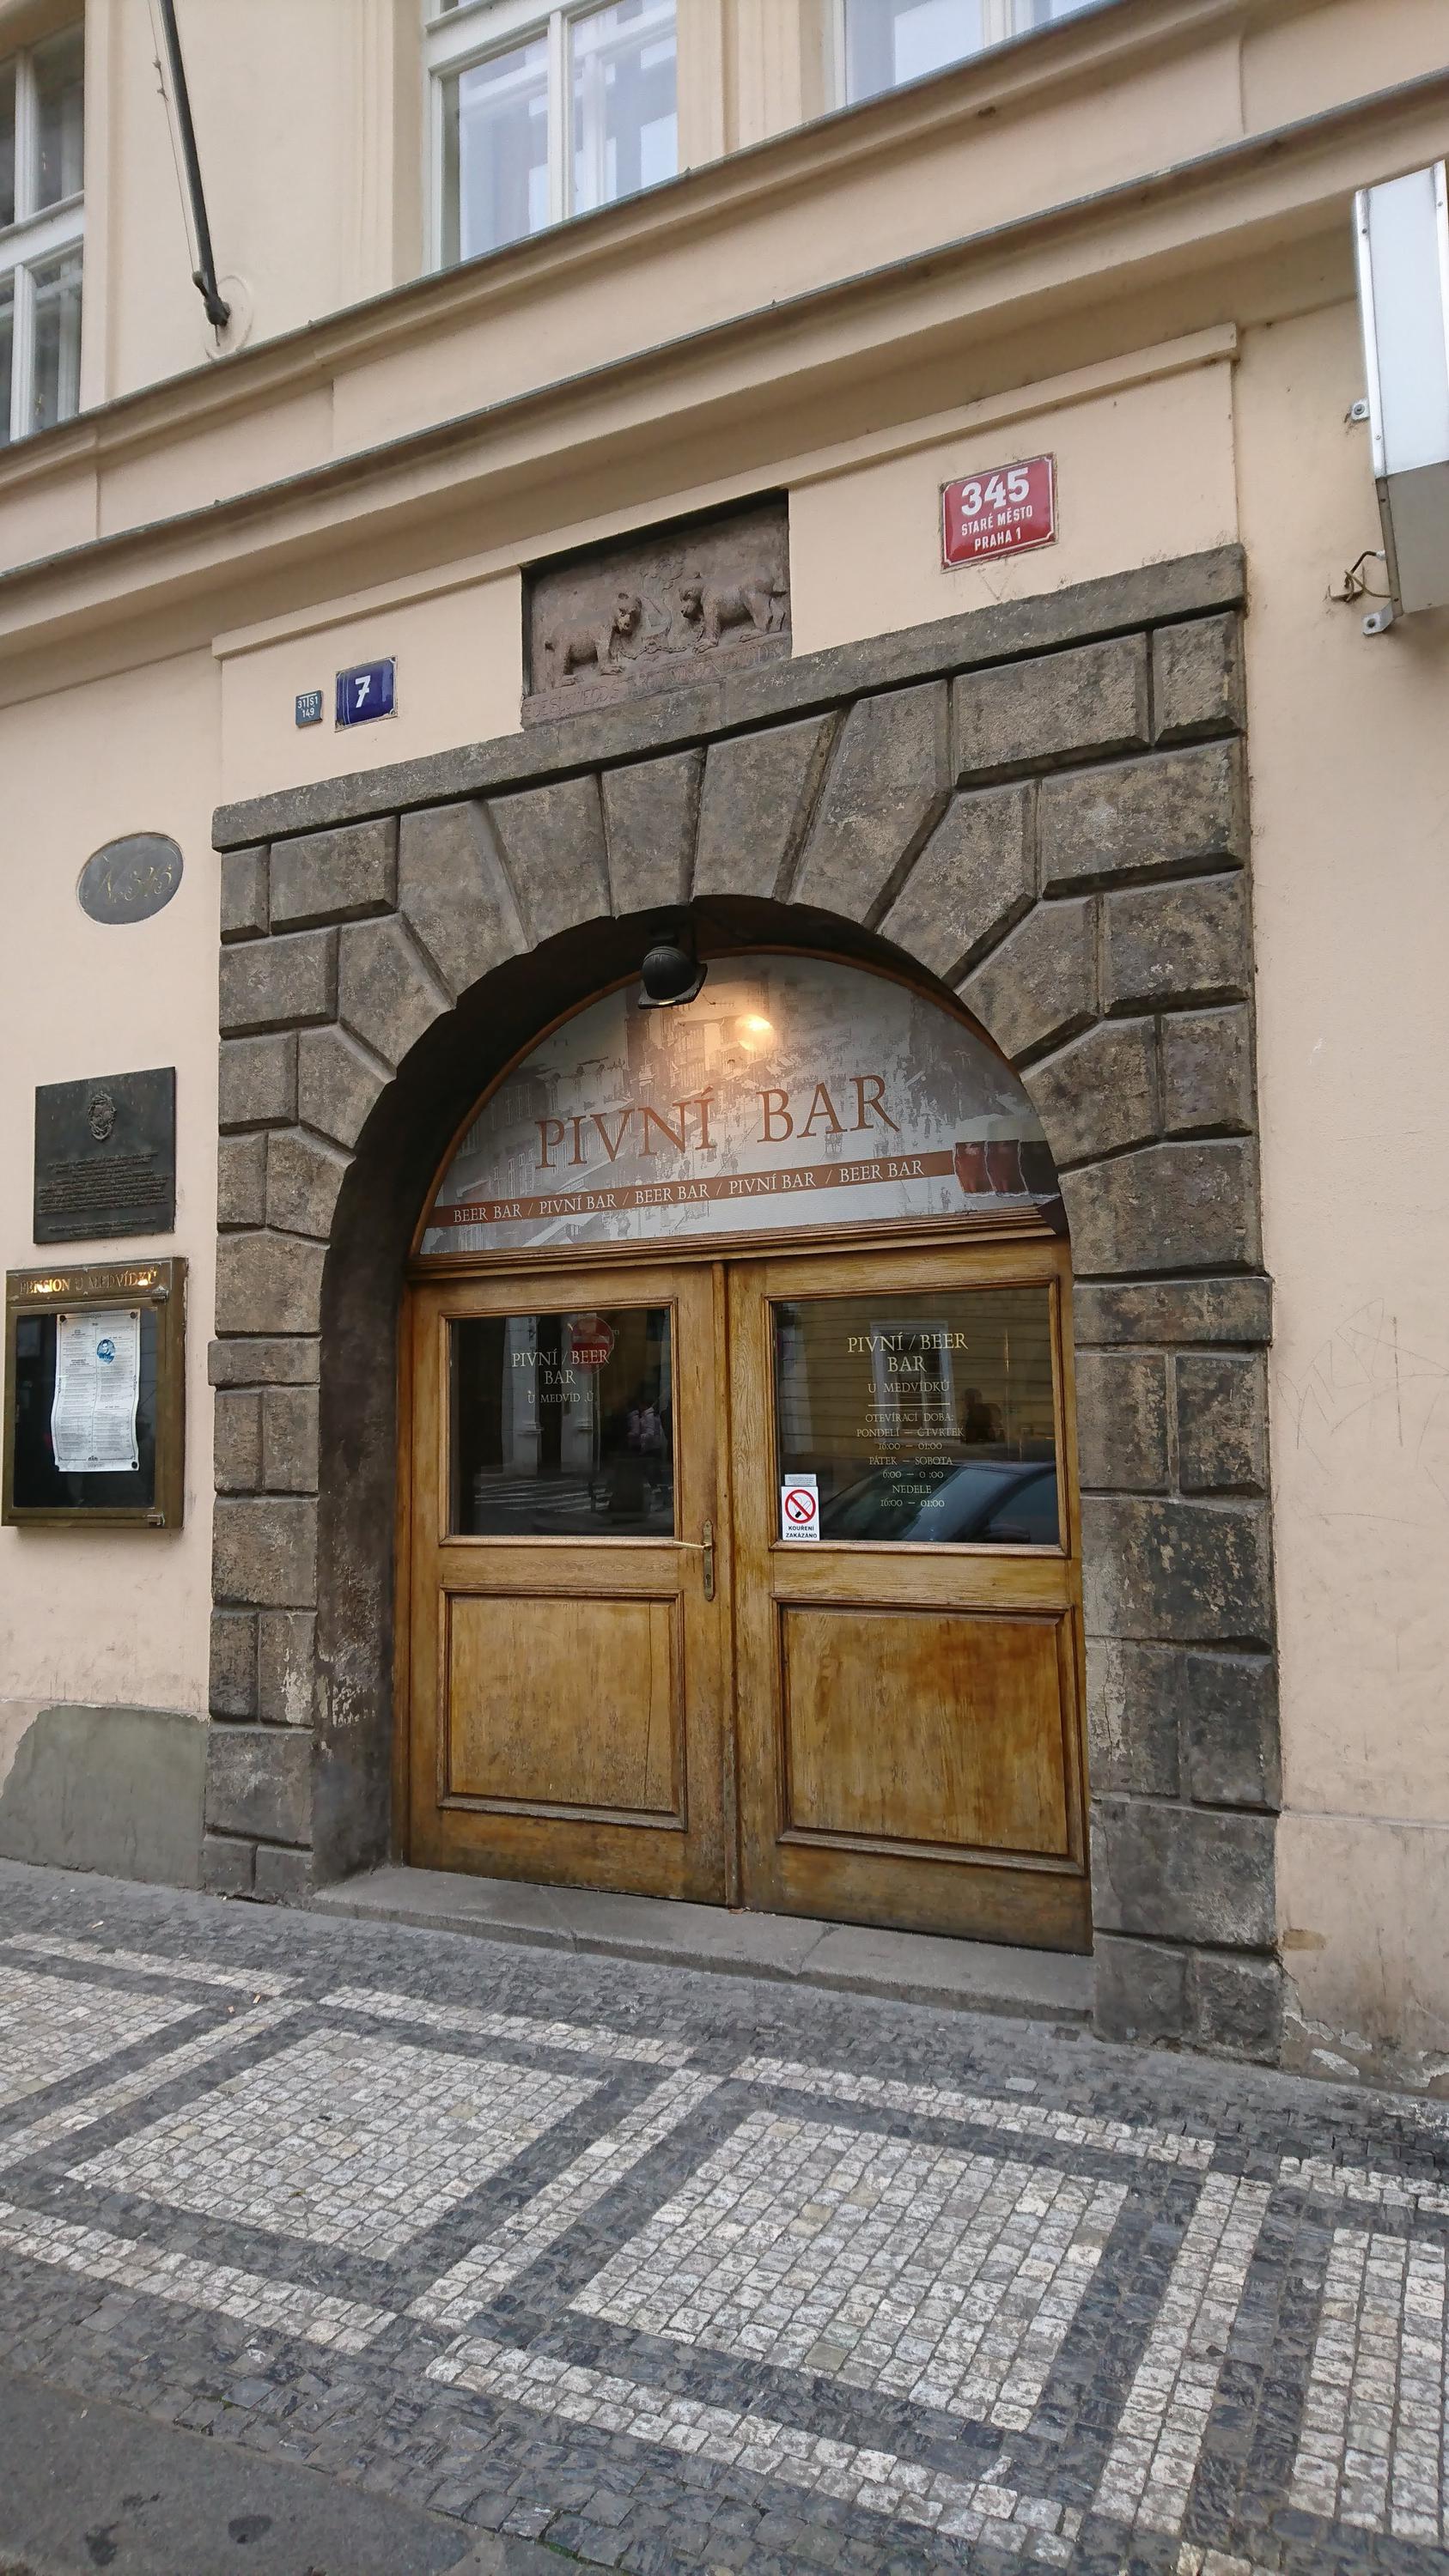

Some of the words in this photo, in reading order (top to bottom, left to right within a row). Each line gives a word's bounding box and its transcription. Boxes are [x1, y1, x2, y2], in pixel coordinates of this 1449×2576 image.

[961, 467, 1030, 516] 345
[961, 513, 994, 536] STARÉ
[997, 505, 1033, 526] MĚSTO
[974, 529, 1013, 551] PRAHA
[1015, 526, 1021, 541] 1
[355, 675, 371, 708] 7
[301, 707, 315, 719] 149
[534, 1086, 715, 1170] PIVNÍ
[756, 1074, 900, 1145] BAR
[453, 1209, 489, 1224] BEER
[492, 1204, 523, 1220] BAR
[539, 1194, 582, 1216] PIVNÍ
[586, 1194, 618, 1211] BAR
[634, 1188, 674, 1206] BEER
[677, 1183, 710, 1200] BAR
[728, 1173, 777, 1195] PIVNÍ
[782, 1172, 817, 1190] BAR
[839, 1164, 884, 1183] BEER
[886, 1159, 925, 1178] BAR
[20, 1277, 71, 1295] PENSION
[847, 1332, 904, 1353] PIVNÍ
[920, 1333, 969, 1351] BEER
[511, 1348, 558, 1368] PIVNÍ
[570, 1349, 610, 1364] BEER
[887, 1356, 928, 1372] BAR
[544, 1370, 577, 1385] BAR
[868, 1382, 876, 1394] U
[917, 1442, 943, 1450] 01:00
[915, 1455, 953, 1466] SOBOTA
[880, 1497, 904, 1507] 16:00
[920, 1499, 946, 1508] 01:00
